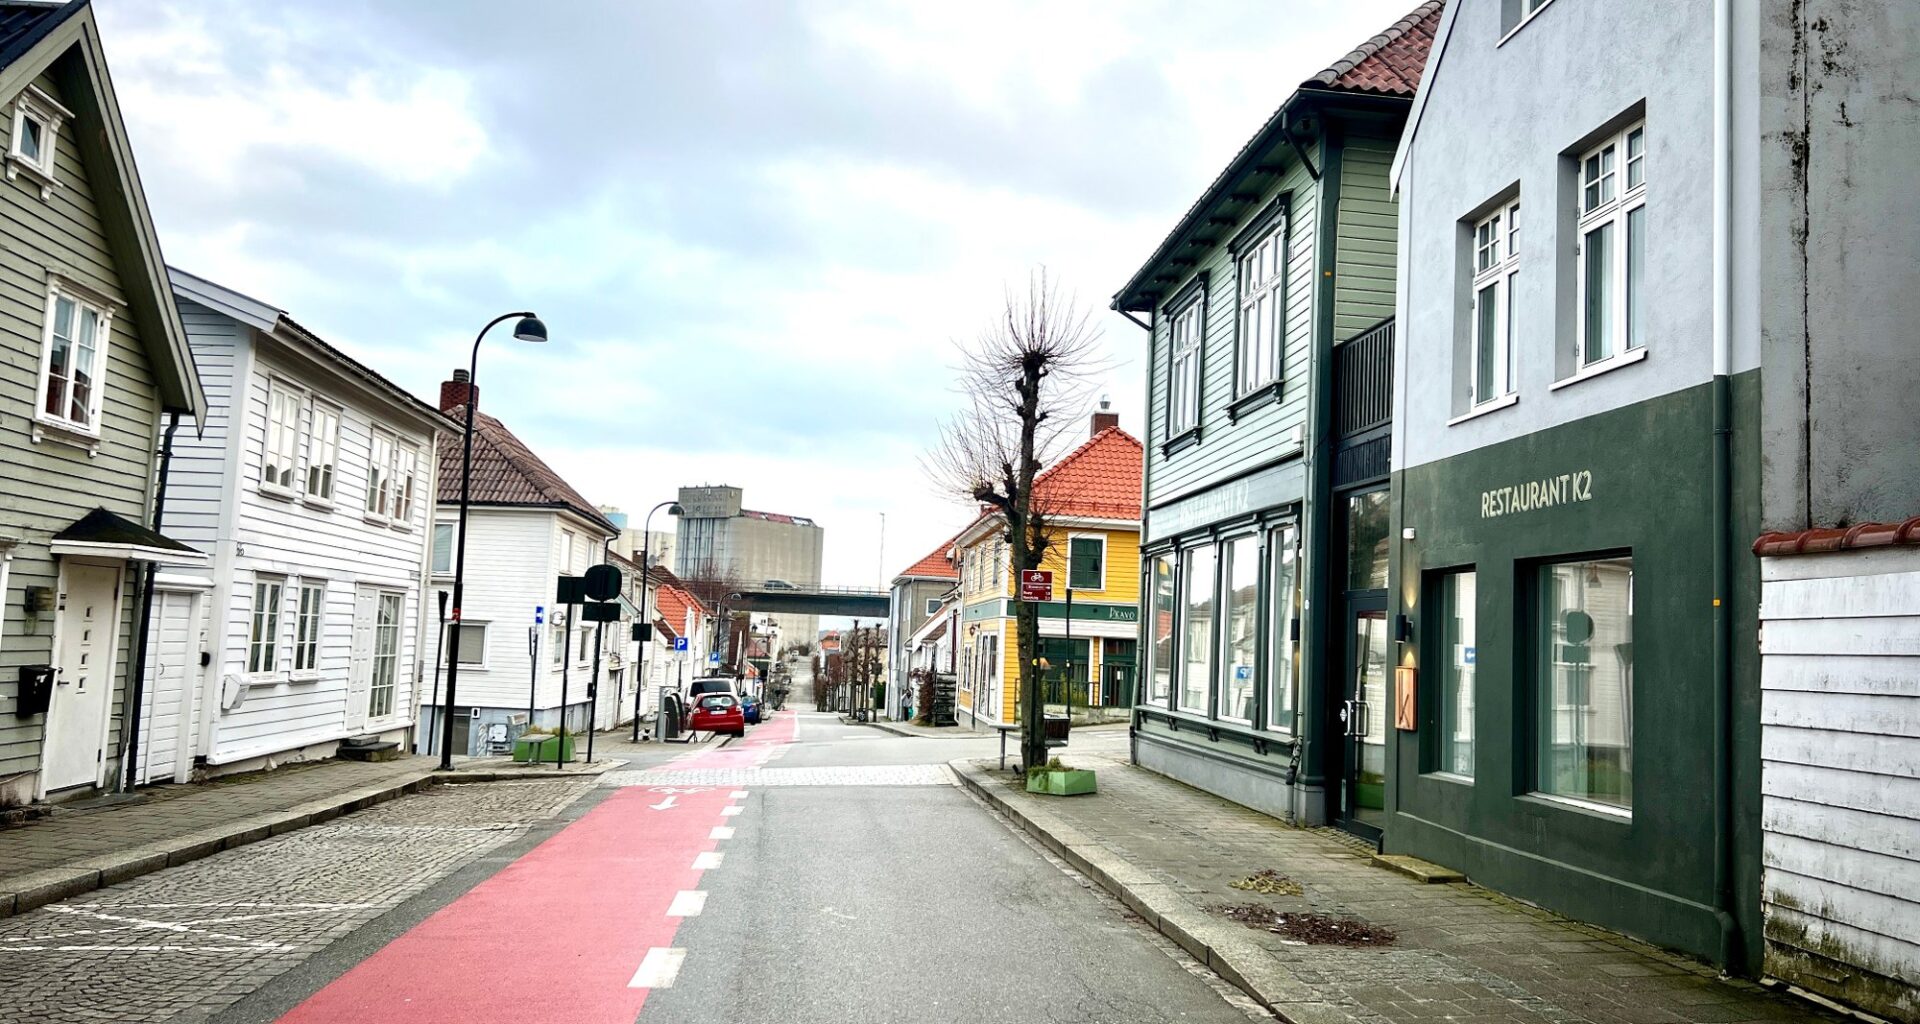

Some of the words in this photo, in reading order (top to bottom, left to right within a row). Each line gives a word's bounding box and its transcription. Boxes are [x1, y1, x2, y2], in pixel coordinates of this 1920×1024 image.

[1481, 474, 1570, 519] RESTAURANT
[1572, 469, 1593, 503] K2
[1398, 670, 1410, 728] K
